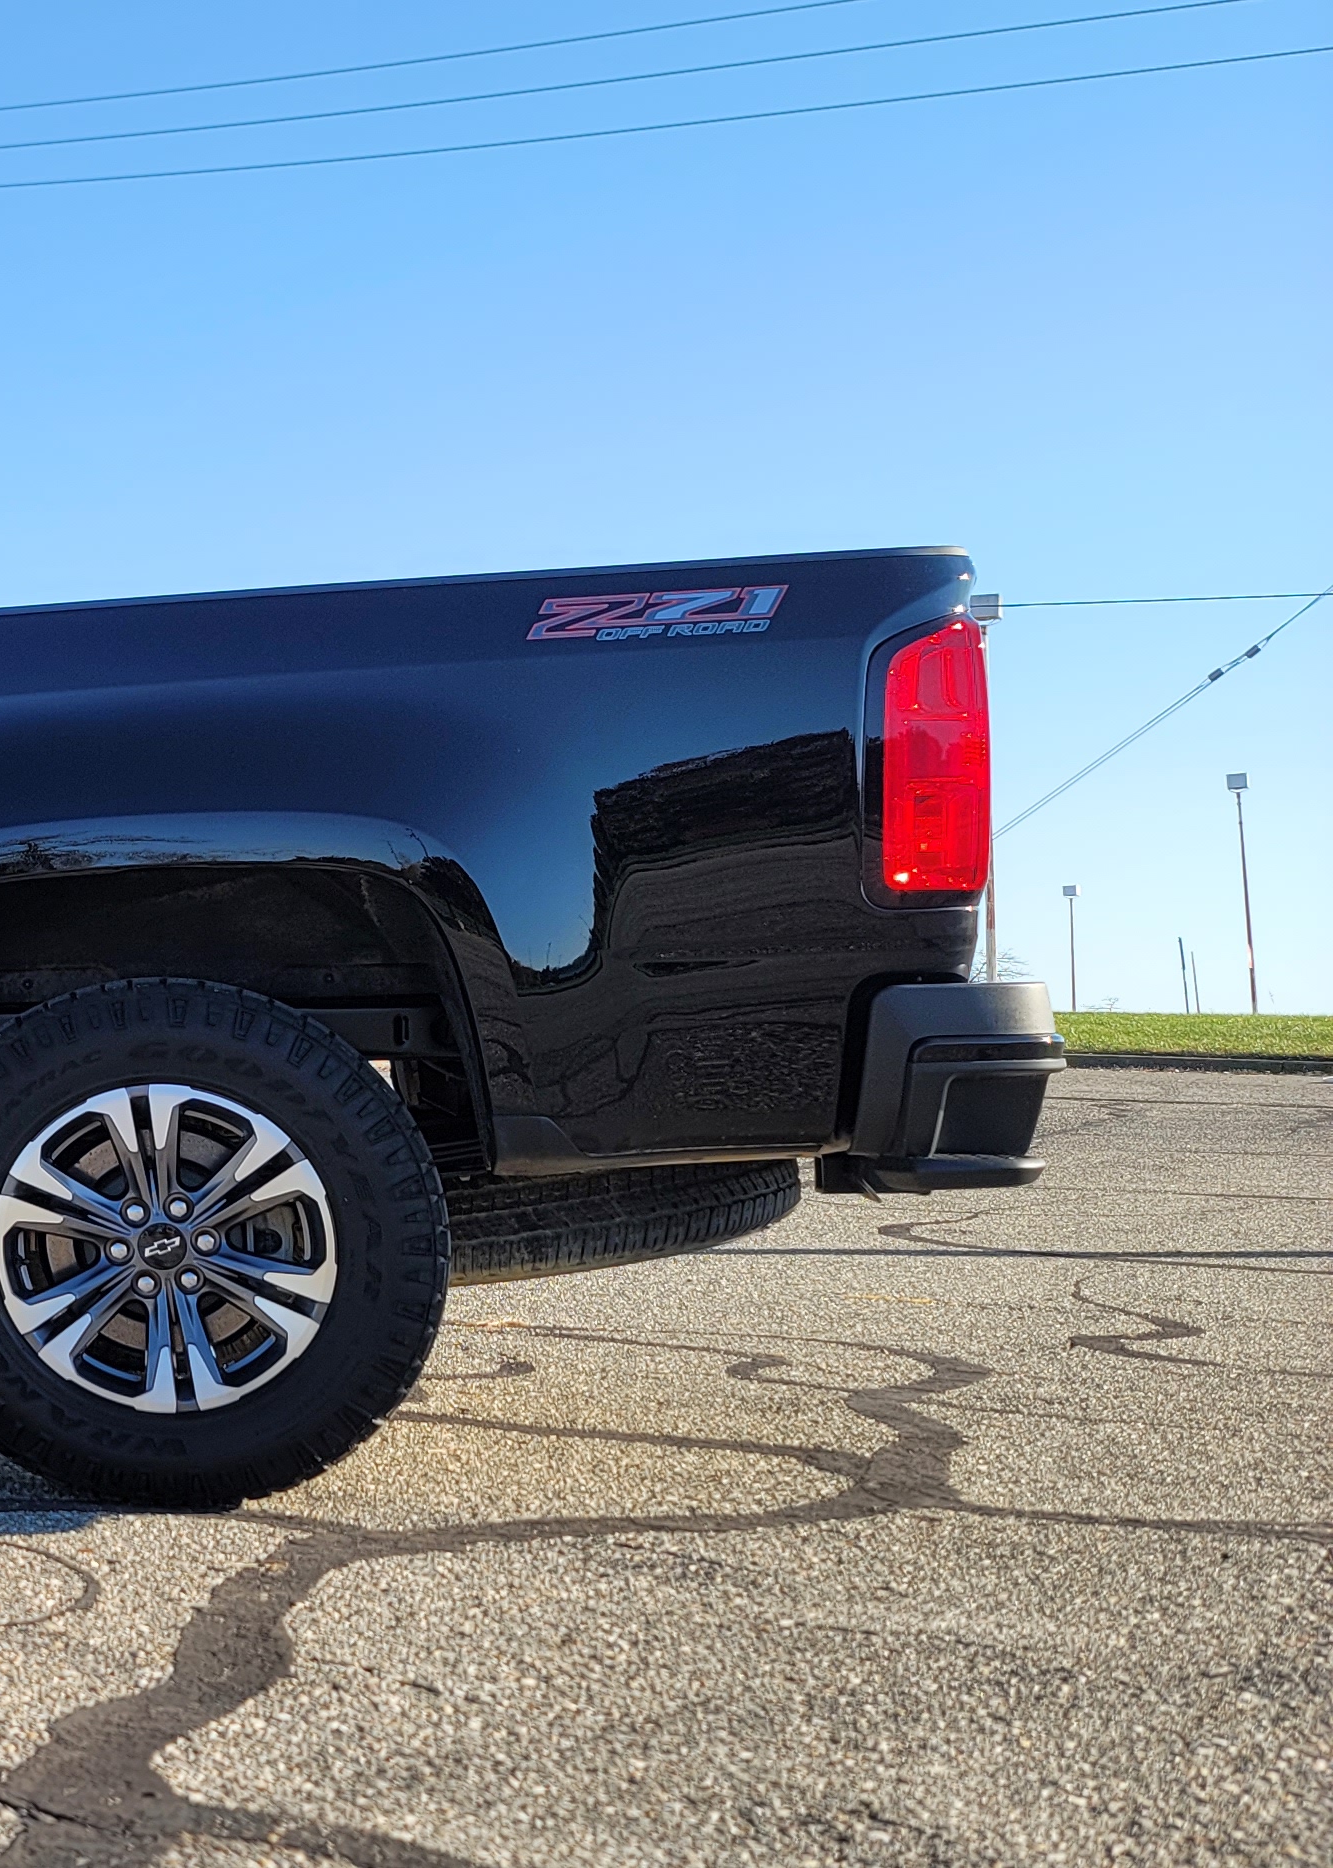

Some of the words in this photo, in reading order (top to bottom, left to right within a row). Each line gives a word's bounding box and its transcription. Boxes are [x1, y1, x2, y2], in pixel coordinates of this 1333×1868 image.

[526, 585, 789, 640] Z71
[596, 625, 665, 641] OFF
[667, 619, 770, 637] ROAD
[127, 1040, 383, 1305] GOODYEAR
